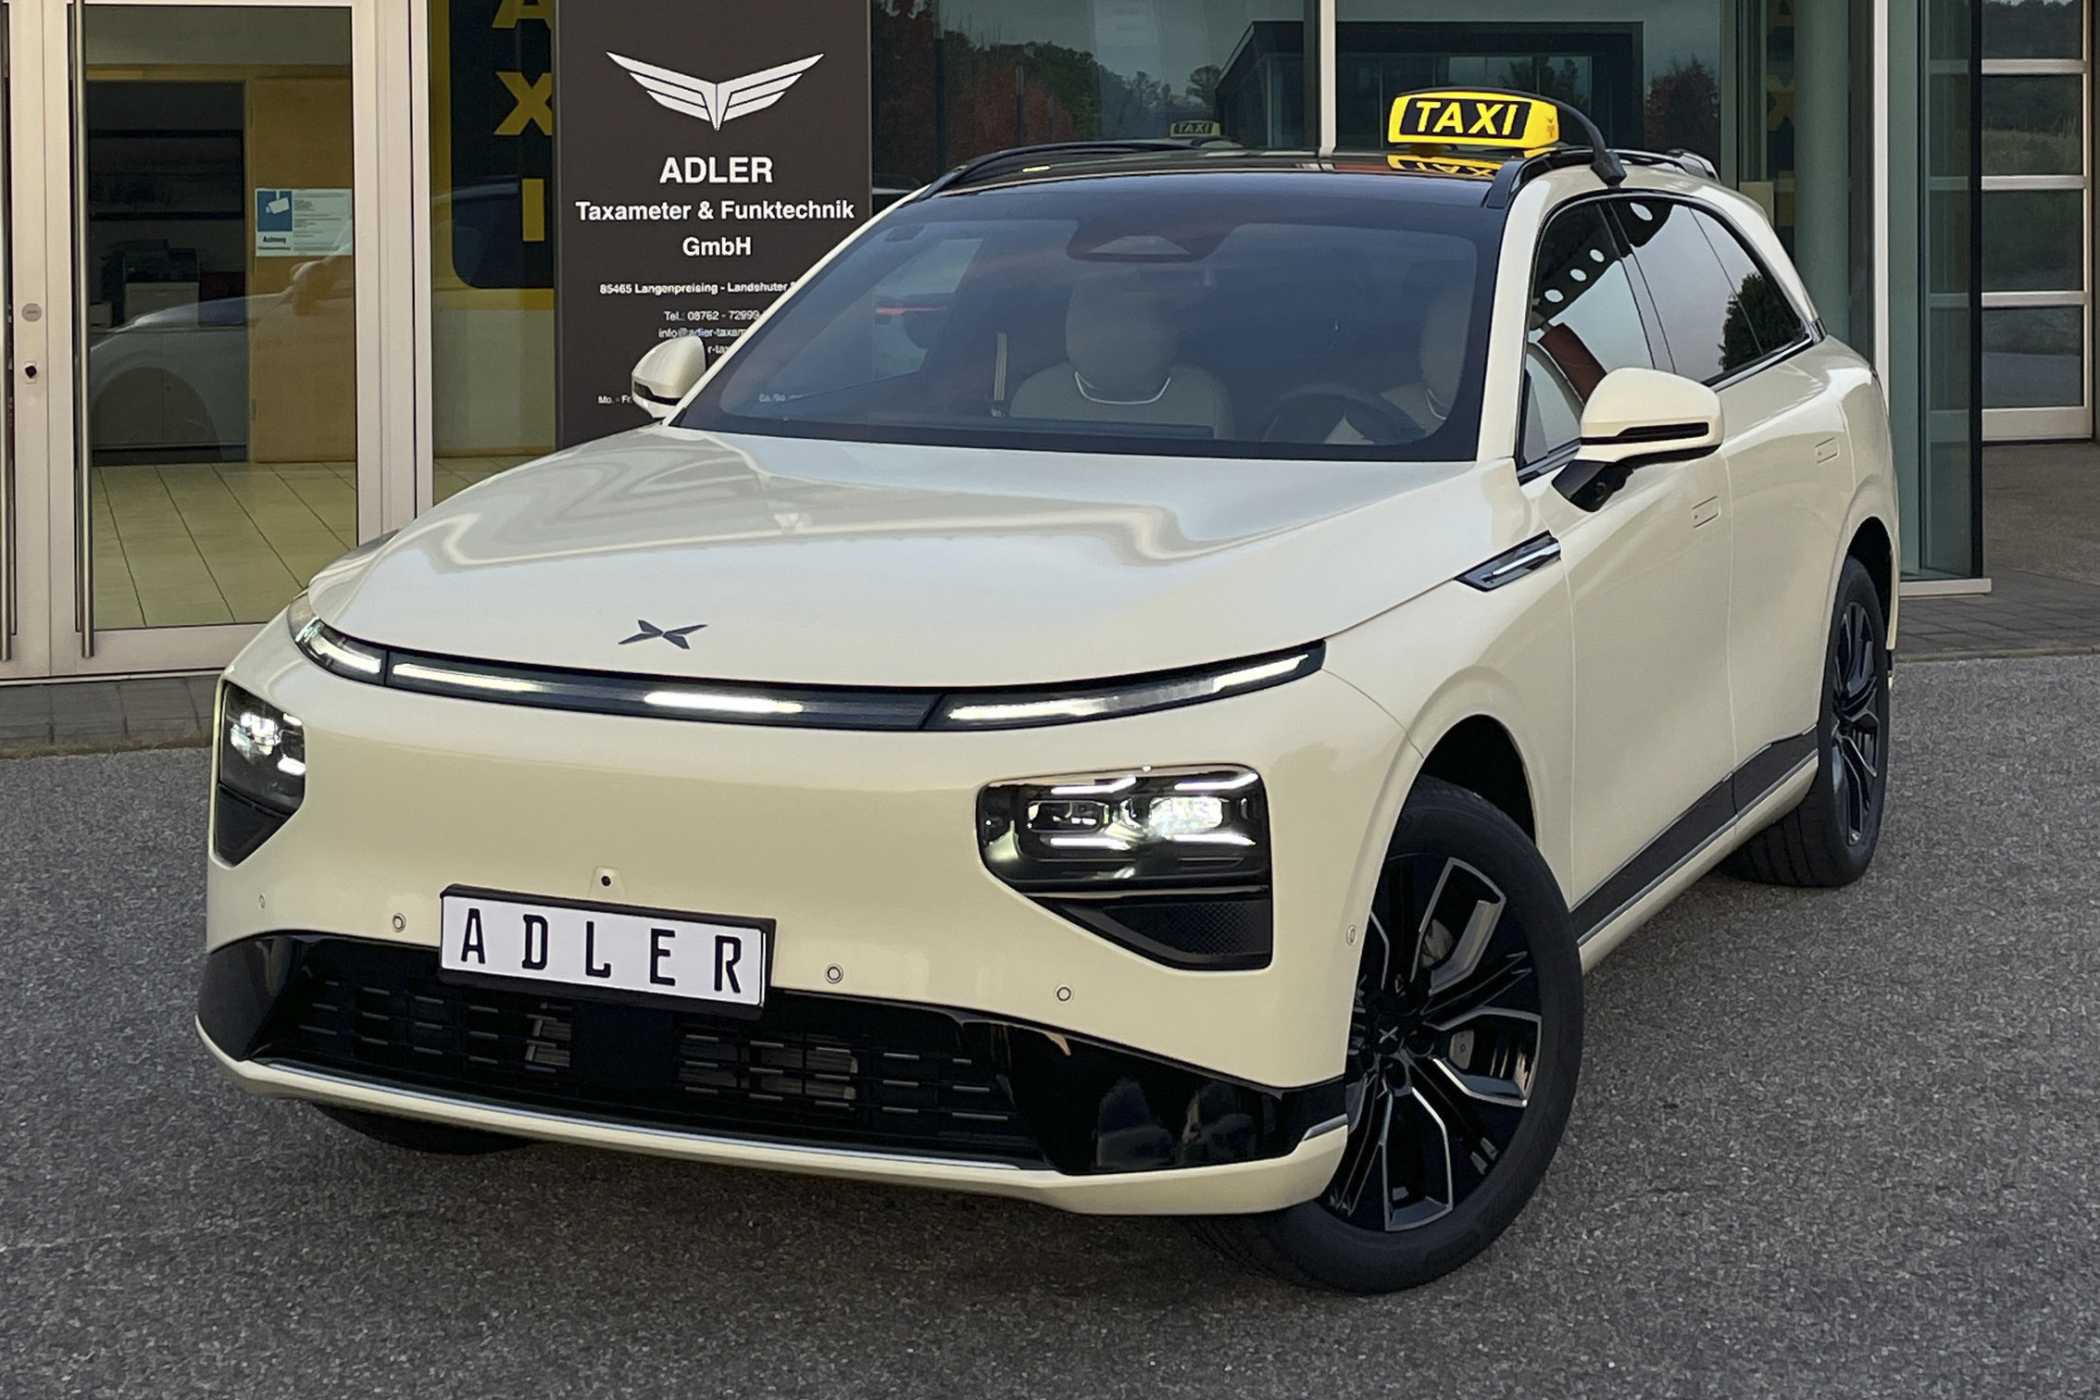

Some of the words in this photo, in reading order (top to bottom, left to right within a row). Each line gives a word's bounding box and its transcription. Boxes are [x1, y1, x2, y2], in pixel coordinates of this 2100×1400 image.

[1415, 101, 1519, 136] TAXI
[659, 156, 774, 184] ADLER
[575, 201, 692, 221] Taxameter
[697, 200, 714, 220] &
[721, 200, 855, 220] Funktechnik
[682, 236, 752, 256] GmbH
[599, 284, 632, 294] 85465
[634, 282, 719, 295] Langenpreising
[727, 281, 788, 292] Landshuter
[687, 310, 720, 321] 08762
[461, 908, 742, 993] ADLER
